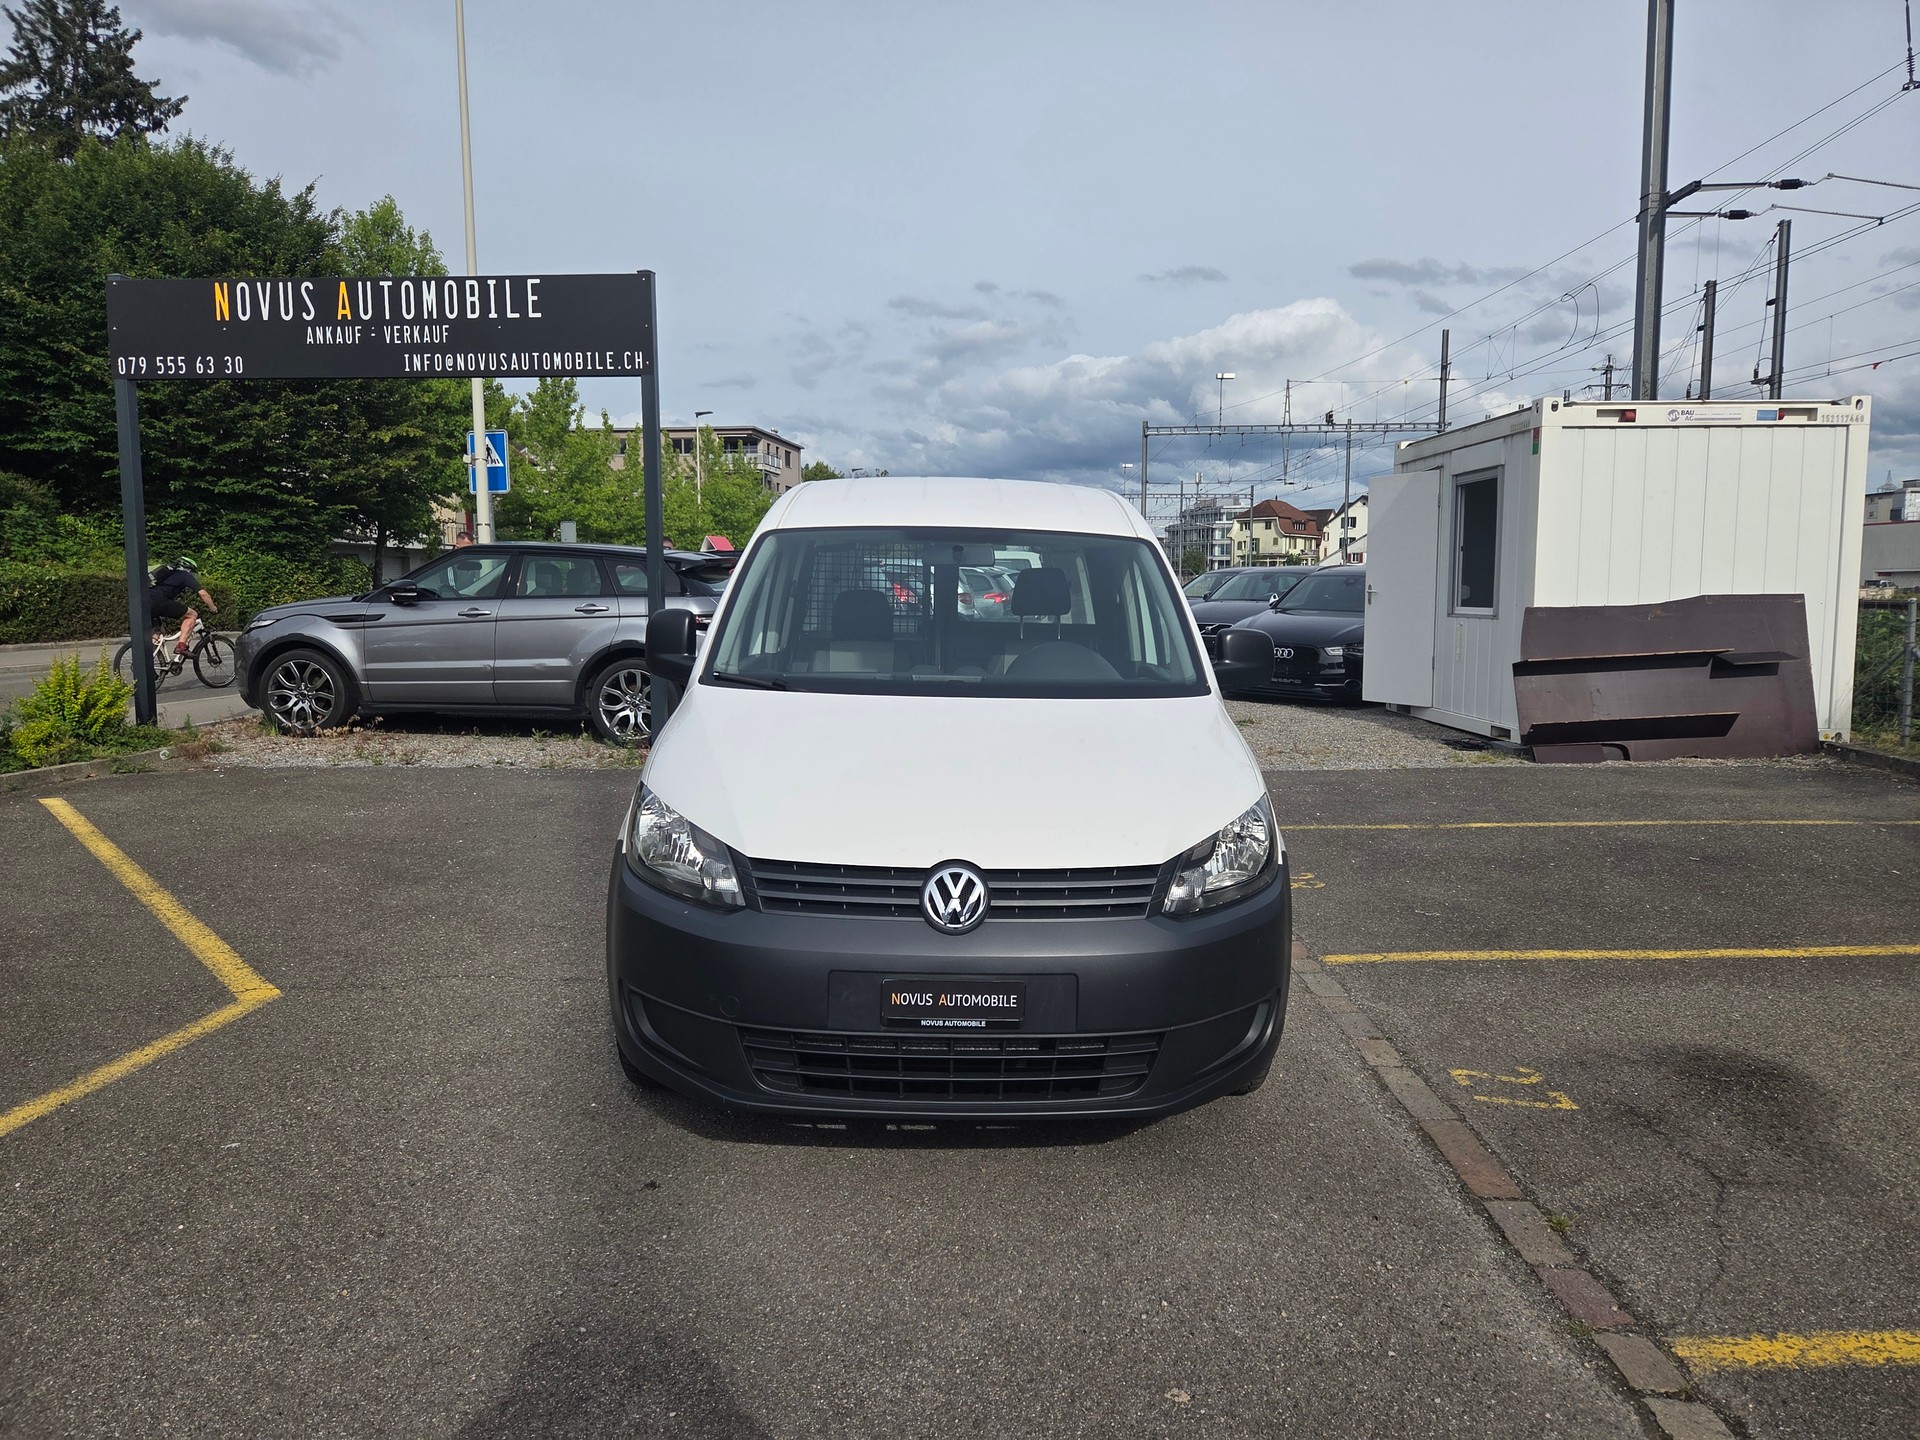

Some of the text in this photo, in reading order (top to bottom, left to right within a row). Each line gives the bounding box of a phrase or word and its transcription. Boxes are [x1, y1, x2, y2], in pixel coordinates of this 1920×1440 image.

[214, 278, 542, 322] NOVUS AUTOMOBILE
[306, 325, 362, 345] ANKAUF
[383, 324, 450, 344] VERKAUF
[117, 355, 244, 375] 079 555 63 30
[403, 351, 643, 372] INFO@NOVUSAUTOMOBILE.CH
[891, 992, 1018, 1008] NOVUS AUTOMOBILE
[920, 1019, 944, 1027] NOVUS
